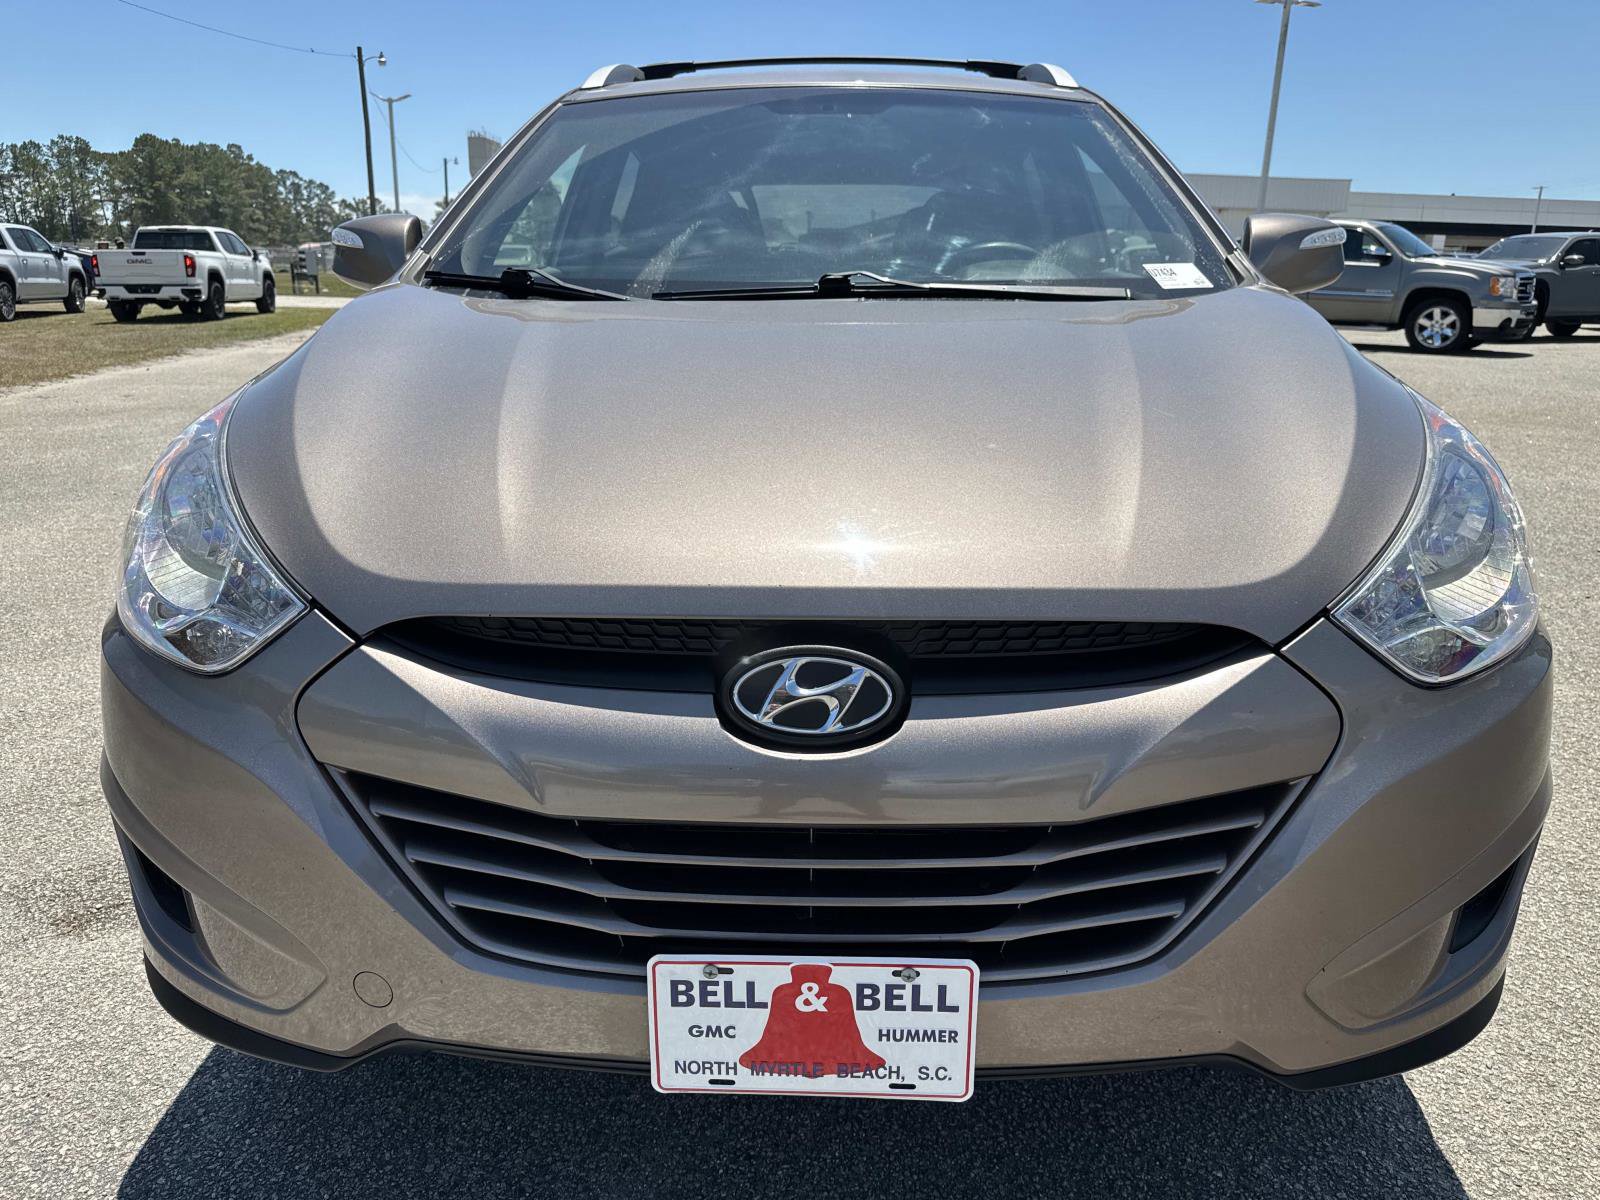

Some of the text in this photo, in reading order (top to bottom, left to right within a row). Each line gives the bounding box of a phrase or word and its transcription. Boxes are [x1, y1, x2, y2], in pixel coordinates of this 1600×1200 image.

[670, 979, 960, 1013] BELL & BELL
[688, 1024, 736, 1039] GMC
[878, 1028, 959, 1044] HUMMER
[674, 1060, 953, 1082] NORTH MYRTLE BEACH, S.C.
